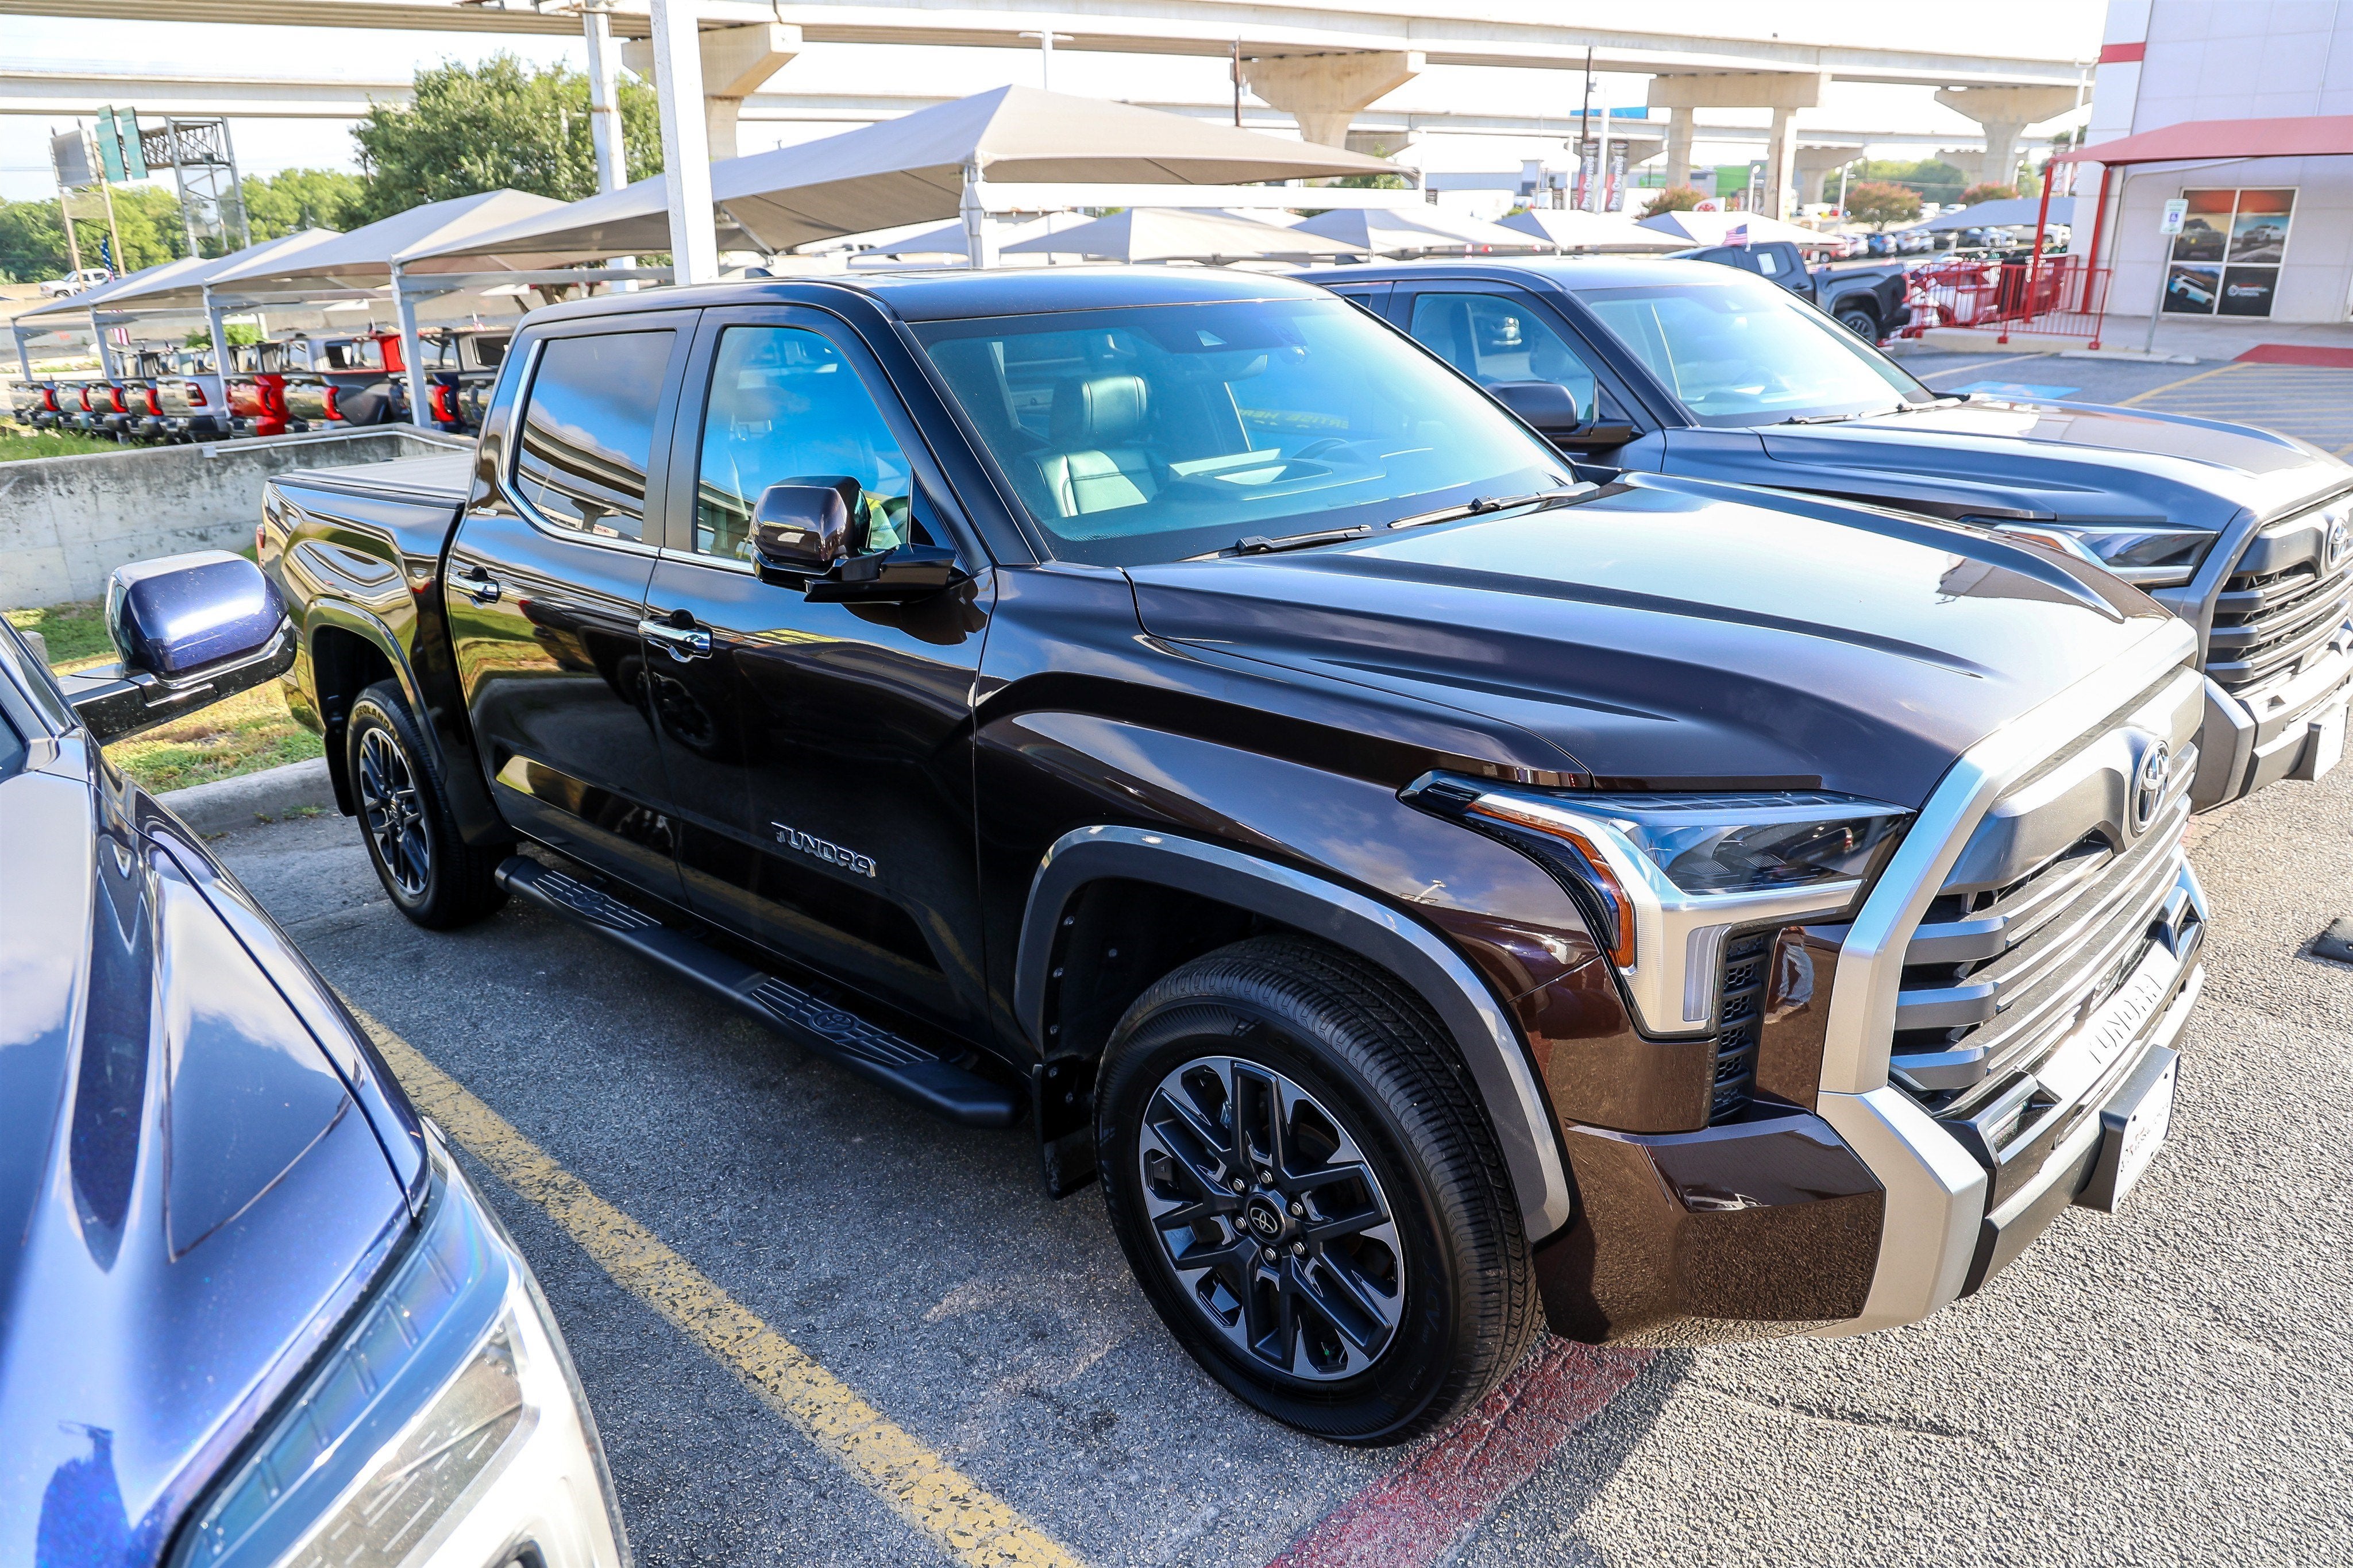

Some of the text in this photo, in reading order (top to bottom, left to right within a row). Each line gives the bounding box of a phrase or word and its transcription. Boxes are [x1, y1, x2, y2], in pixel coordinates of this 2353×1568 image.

[1584, 156, 1594, 191] Owned
[1613, 156, 1623, 191] Owned
[1581, 192, 1592, 208] Pre
[1608, 192, 1619, 208] Pre
[771, 821, 877, 878] TUNDRA
[2088, 974, 2163, 1064] TUNDRA
